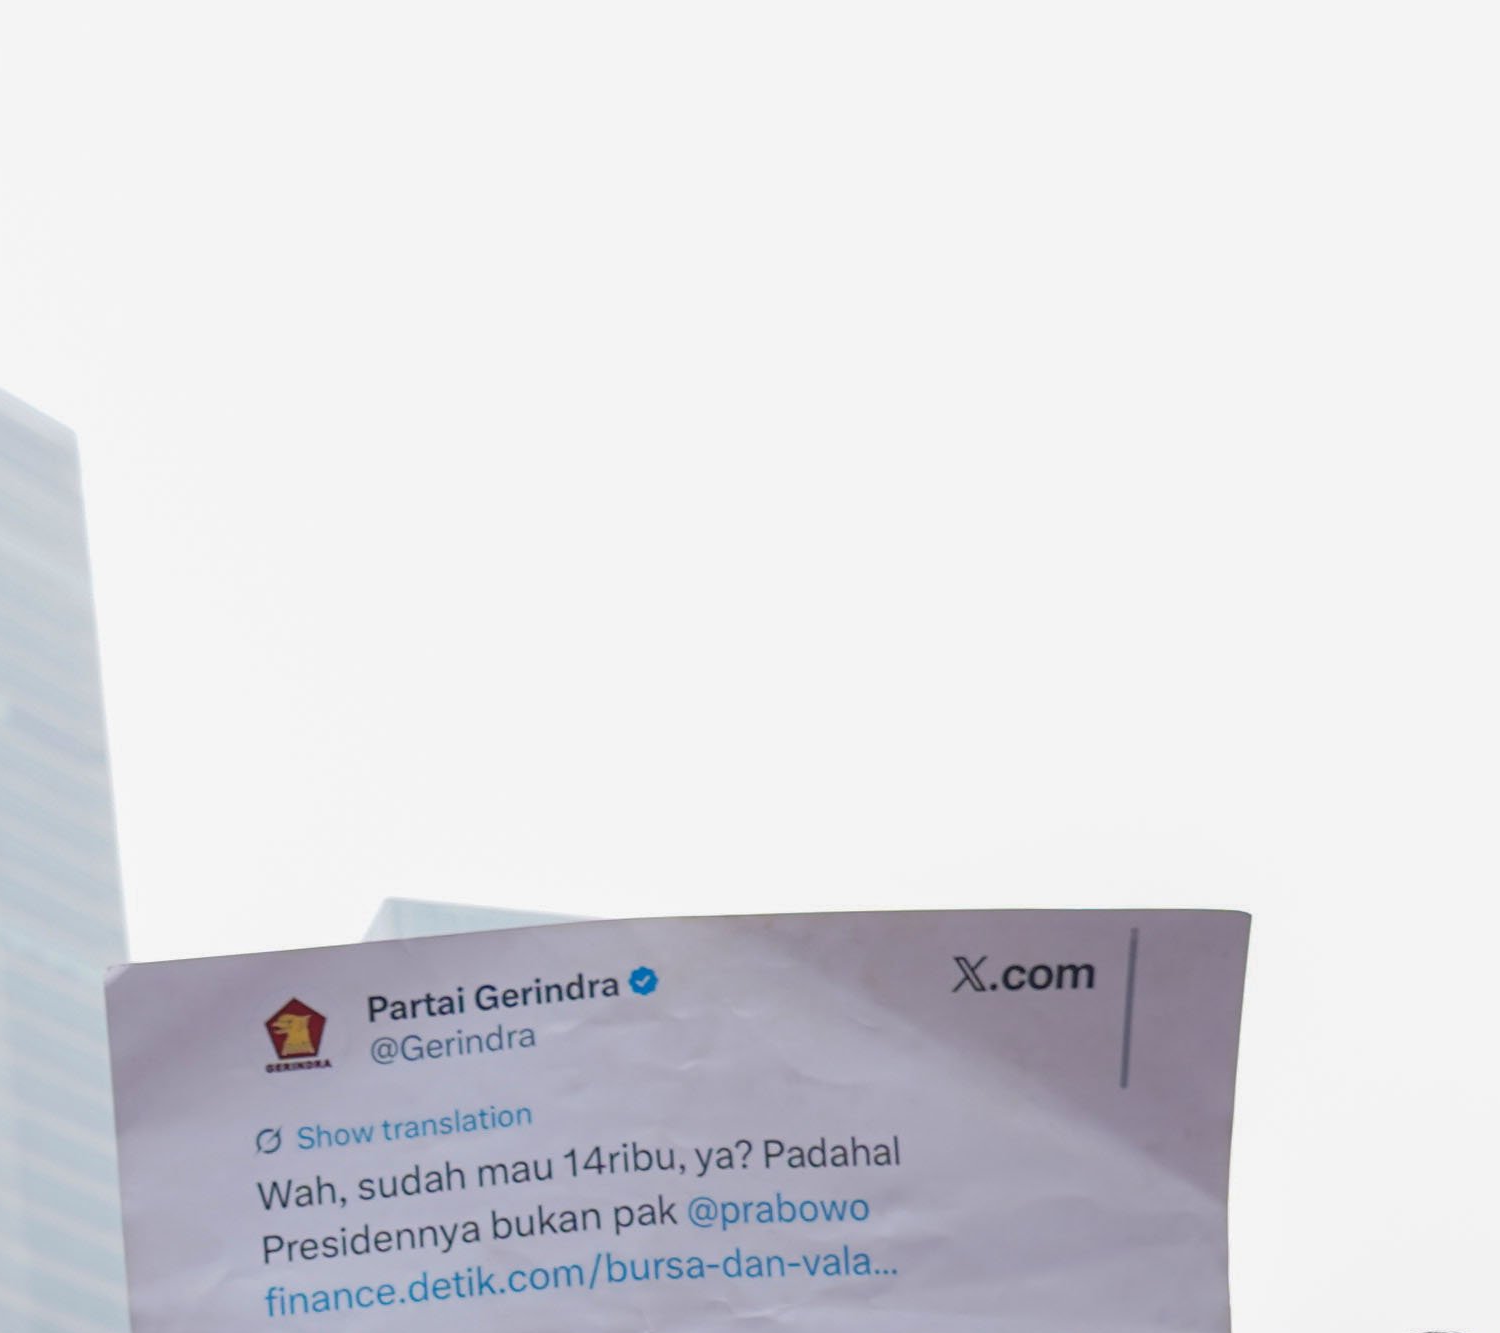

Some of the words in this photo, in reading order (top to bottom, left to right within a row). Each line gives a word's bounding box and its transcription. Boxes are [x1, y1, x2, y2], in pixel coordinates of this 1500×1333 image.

[368, 987, 464, 1023] Partai
[475, 973, 619, 1012] Gerindra
[266, 1059, 333, 1074] GERINDRA
[371, 1024, 537, 1065] @Gerindra
[298, 1126, 373, 1151] Show
[382, 1105, 533, 1142] translation
[258, 1179, 347, 1214] Wah,
[358, 1160, 466, 1203] sudah
[478, 1156, 553, 1187] mau
[563, 1144, 686, 1180] 14ribu,
[696, 1141, 753, 1179] ya?
[763, 1134, 900, 1171] Padahal
[262, 1220, 480, 1267] Presidennya
[492, 1203, 600, 1241] bukan
[614, 1196, 678, 1235] pak
[688, 1195, 870, 1232] @prabowo
